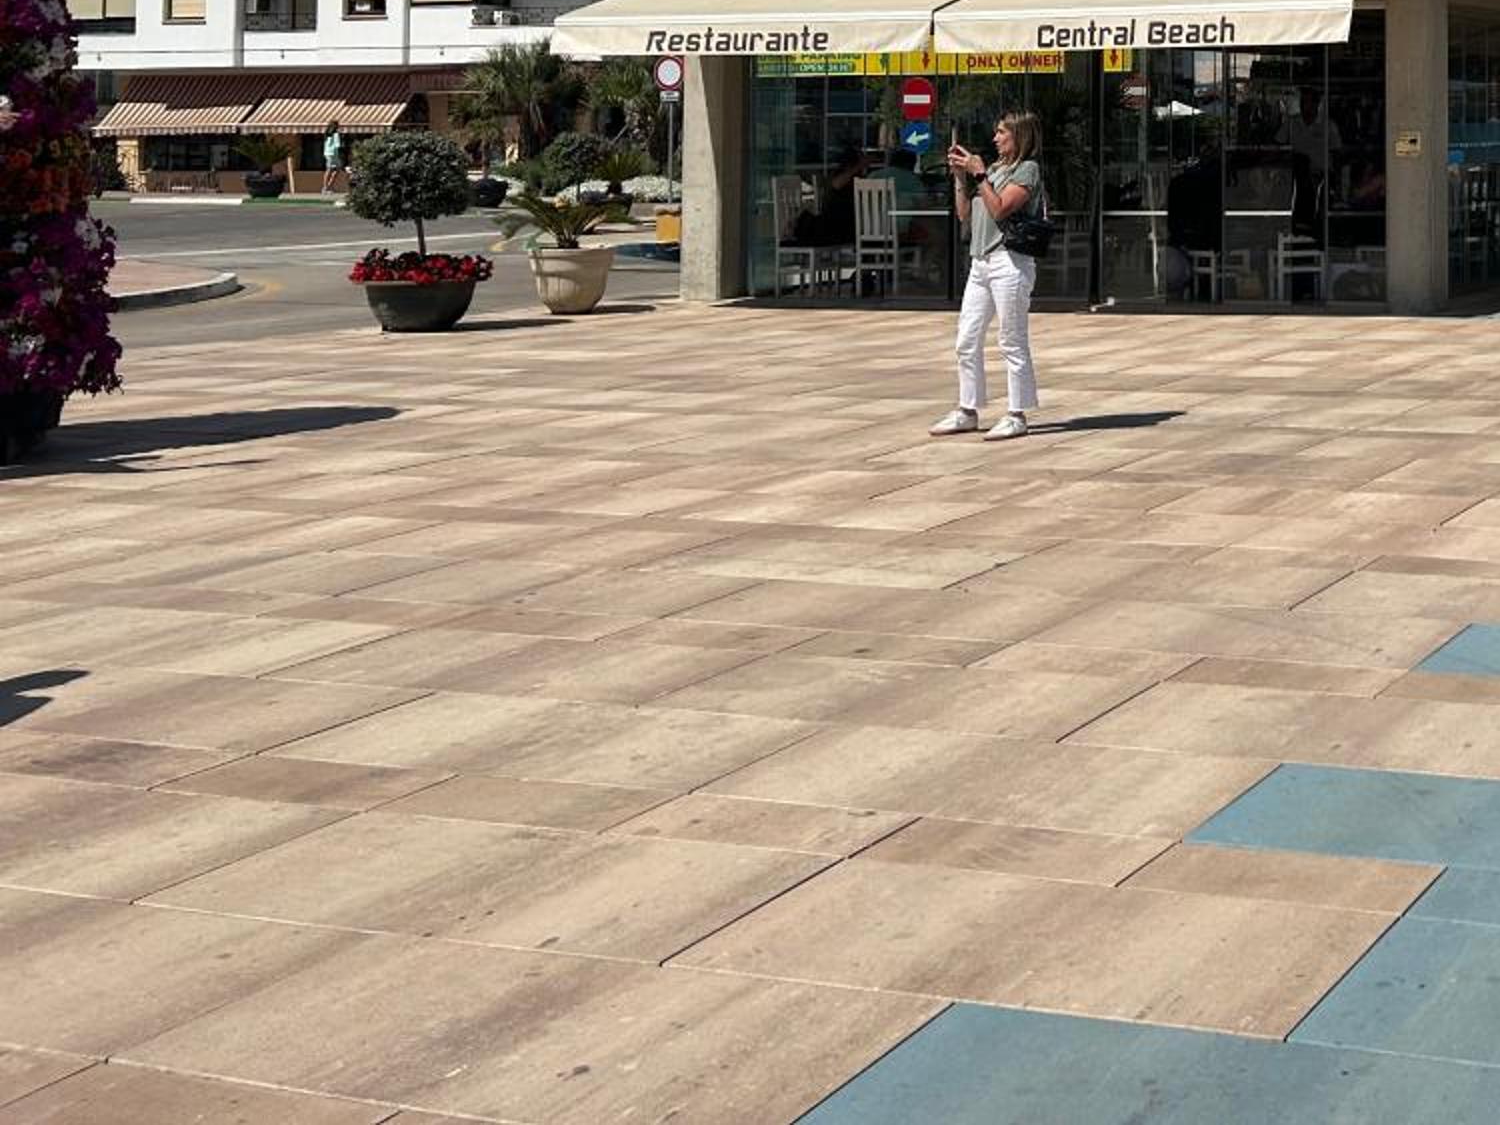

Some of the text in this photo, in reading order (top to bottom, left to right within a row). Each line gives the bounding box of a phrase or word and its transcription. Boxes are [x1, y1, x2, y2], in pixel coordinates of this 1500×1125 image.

[646, 25, 829, 53] Restaurante
[1037, 16, 1235, 48] Central Beach
[966, 54, 1002, 69] ONLY
